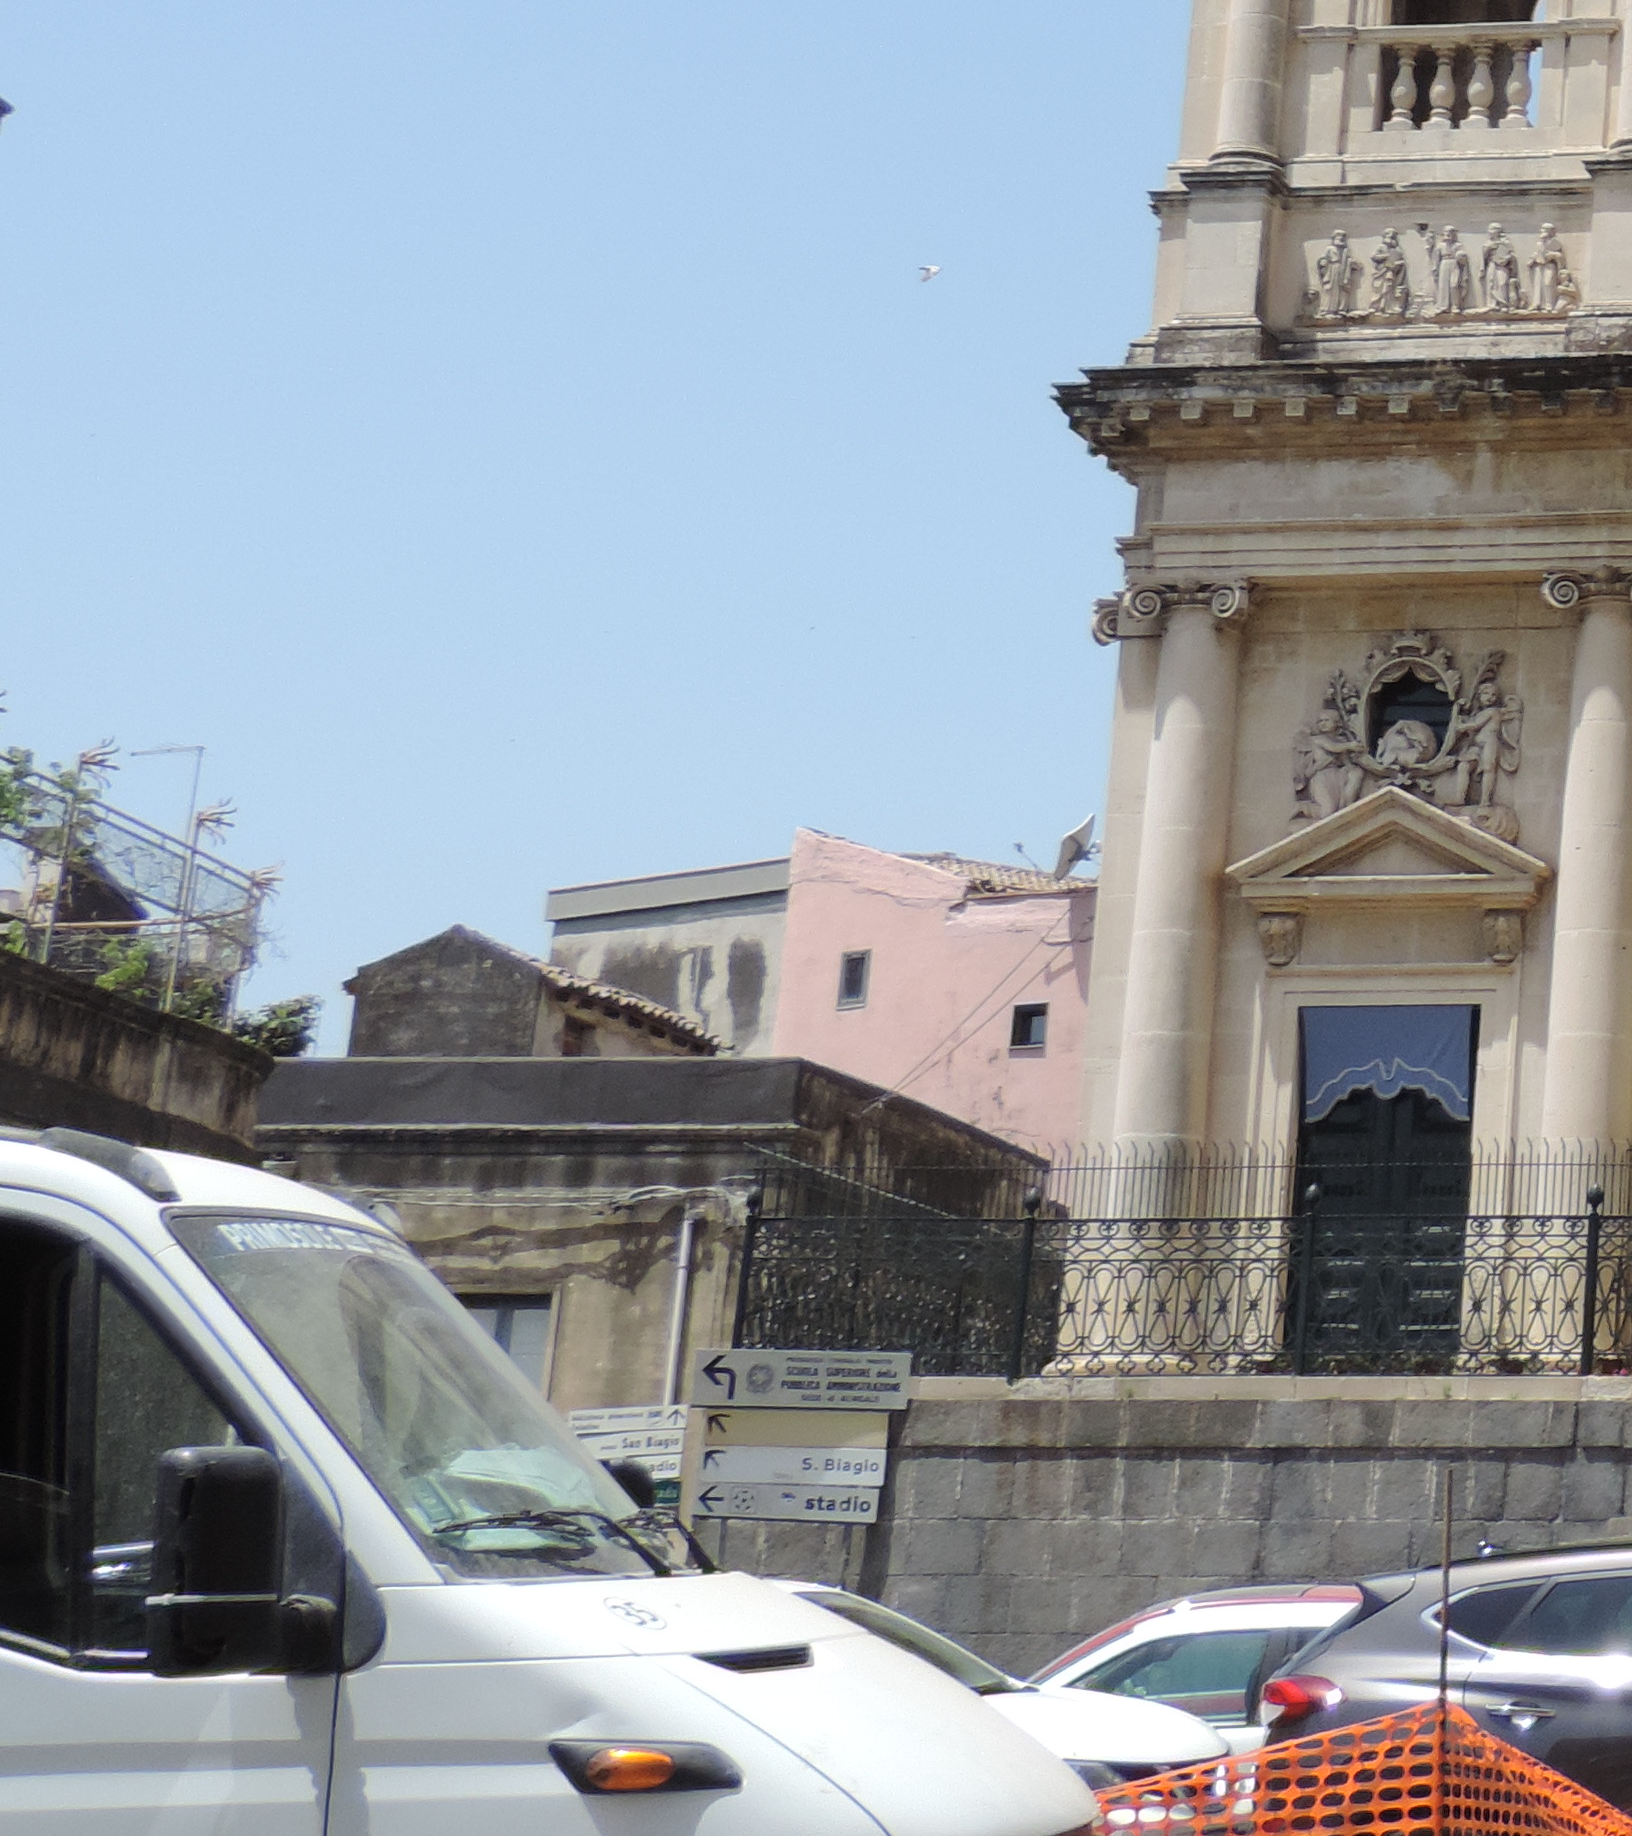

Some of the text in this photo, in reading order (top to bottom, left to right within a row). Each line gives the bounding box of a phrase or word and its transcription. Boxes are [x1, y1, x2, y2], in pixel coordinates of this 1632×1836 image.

[801, 1456, 880, 1476] S. Biagio
[804, 1494, 872, 1514] stadio
